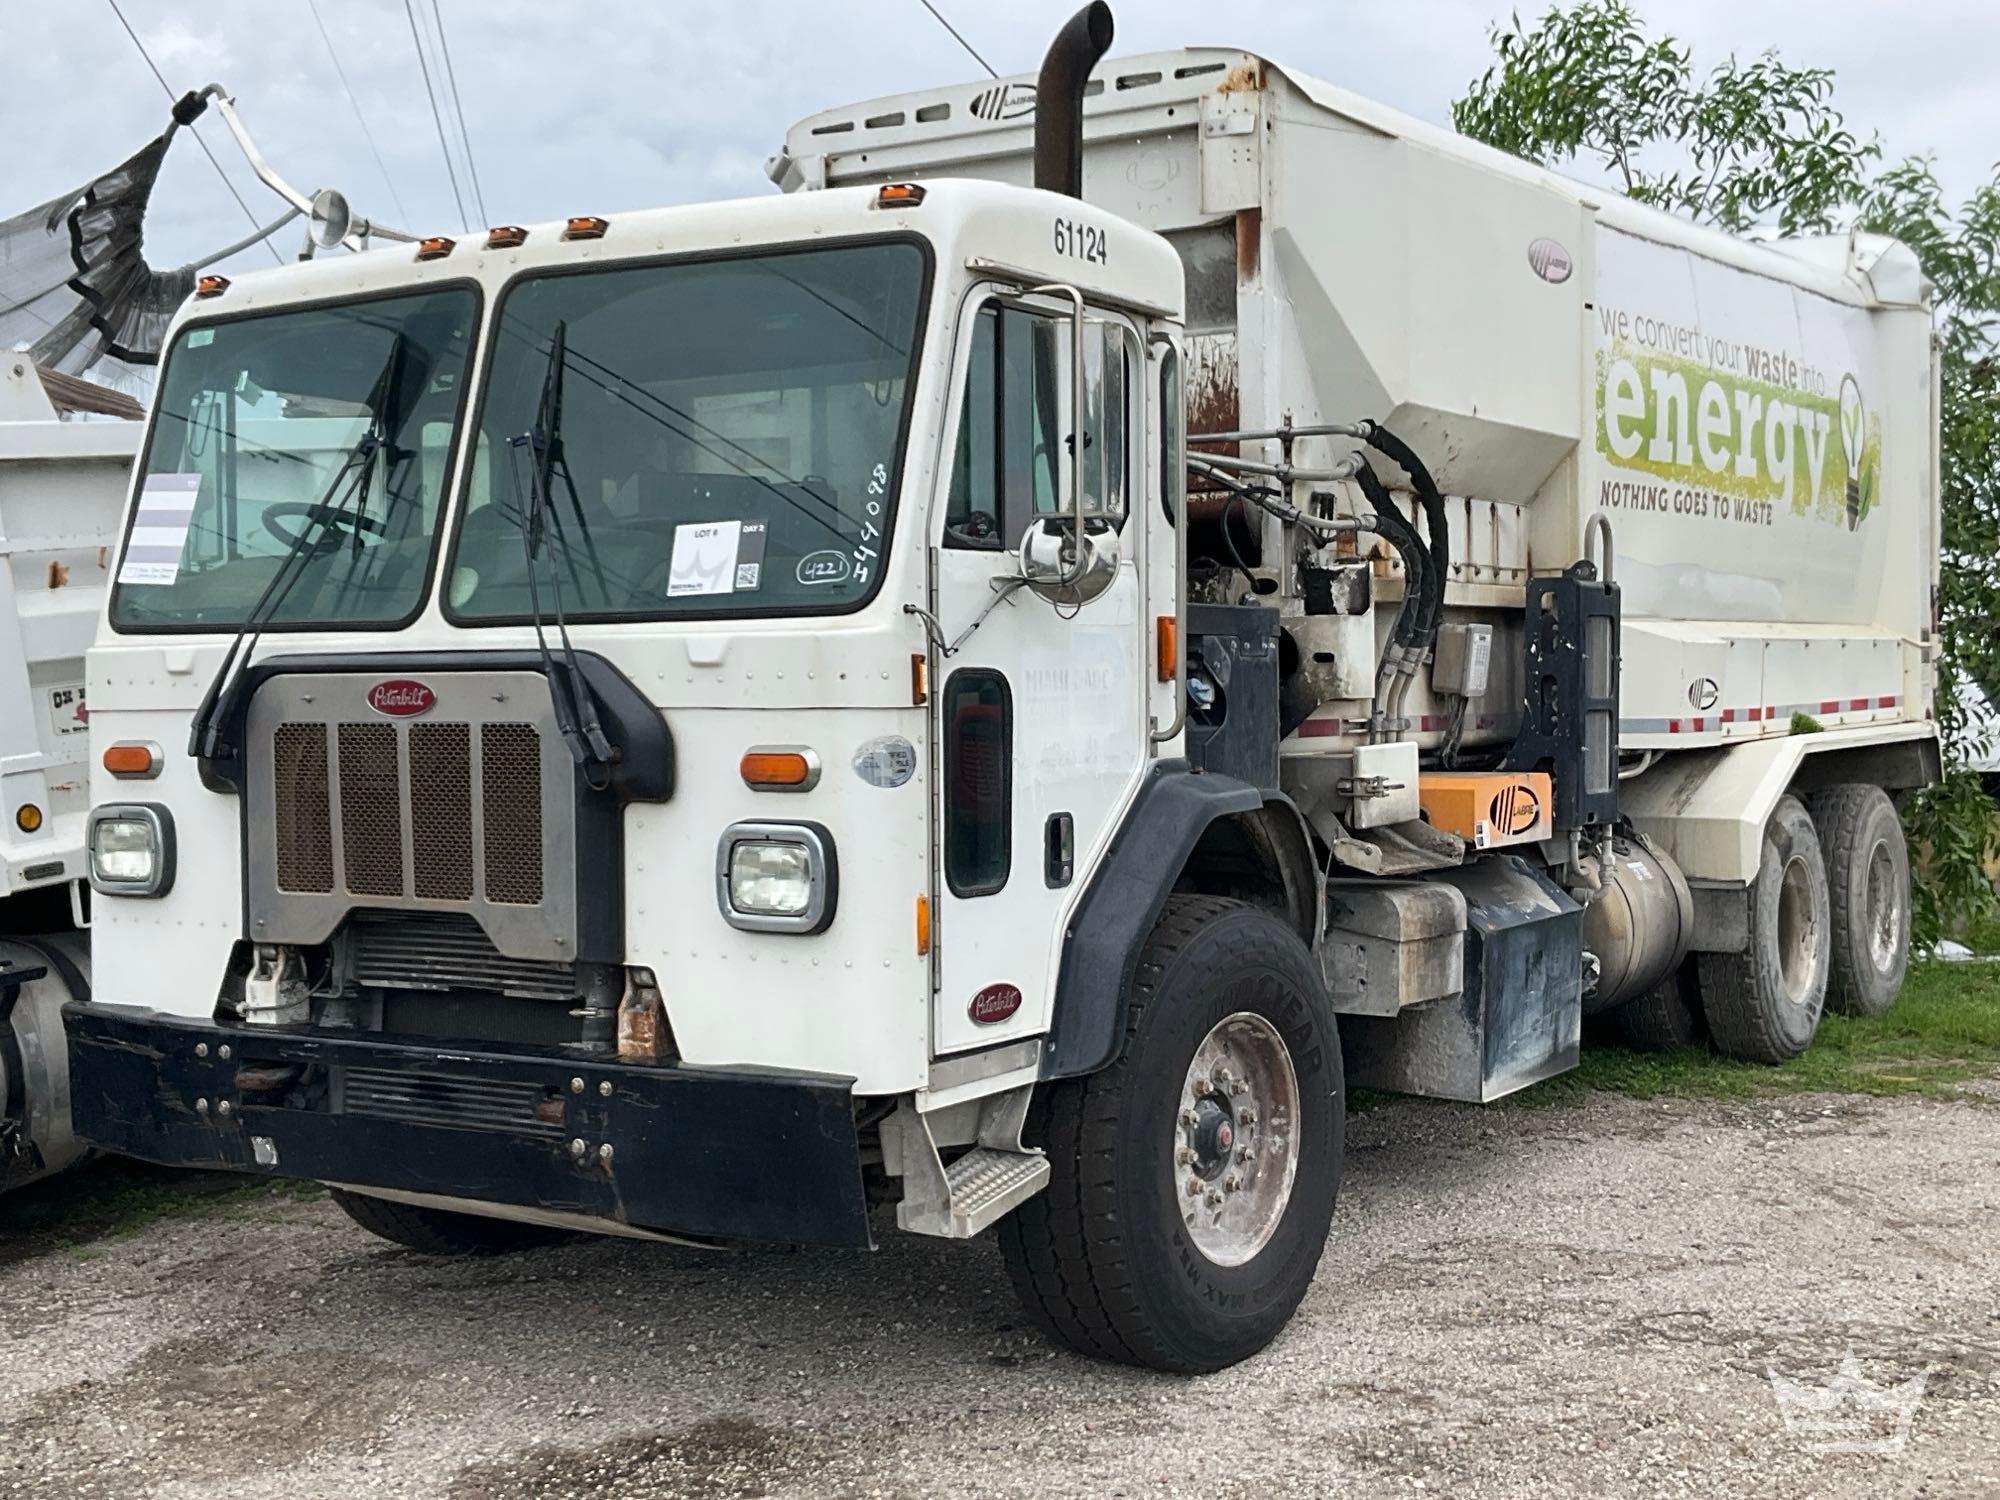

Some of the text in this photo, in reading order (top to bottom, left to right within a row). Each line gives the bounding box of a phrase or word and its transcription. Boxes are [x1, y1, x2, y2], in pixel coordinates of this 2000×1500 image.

[1054, 217, 1107, 266] 61124
[1599, 305, 1825, 397] we convert your waste into
[1605, 359, 1830, 513] energy
[1600, 480, 1773, 526] NOTHING GOES TO WASTE
[694, 529, 711, 539] LOT
[742, 525, 757, 533] DAY
[805, 560, 843, 579] 4221
[374, 686, 428, 708] Peterbilt
[975, 990, 1018, 1017] Peterbilt
